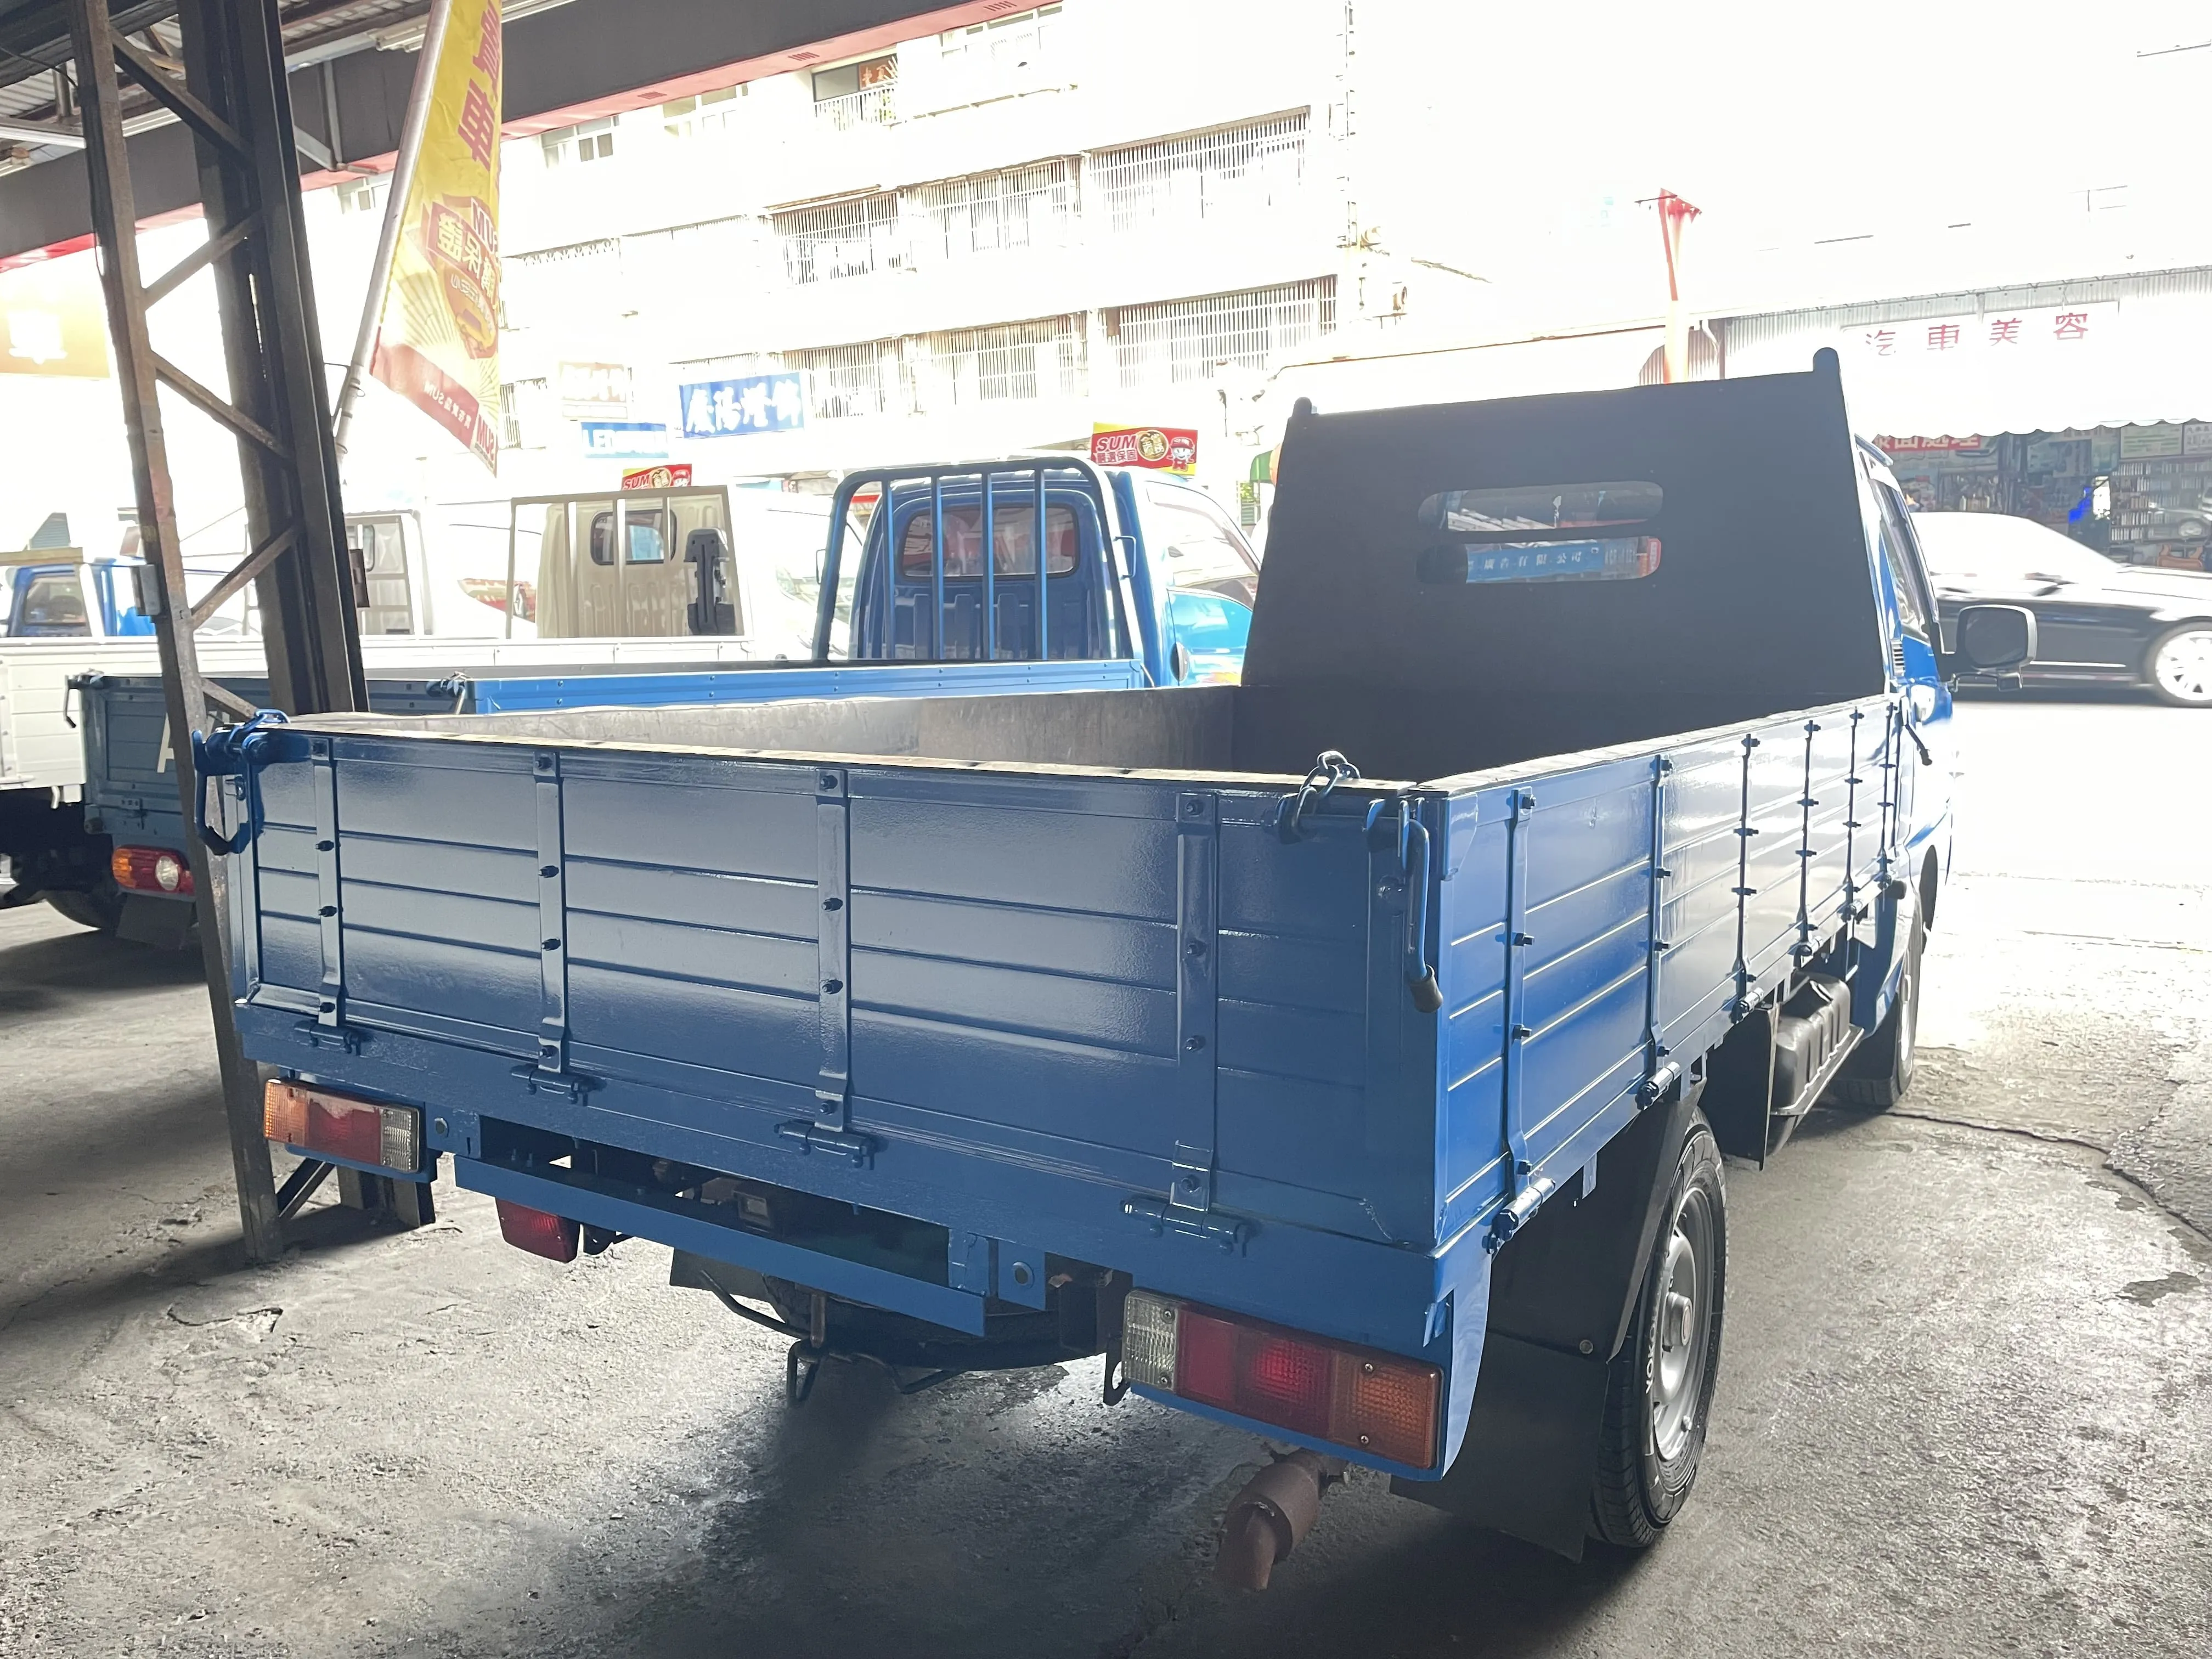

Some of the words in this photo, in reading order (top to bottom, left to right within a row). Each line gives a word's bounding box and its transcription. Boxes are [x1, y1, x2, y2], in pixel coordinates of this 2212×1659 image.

[1865, 312, 2089, 356] 汽車美容
[1097, 435, 1137, 452] SUM
[624, 474, 650, 489] SUM
